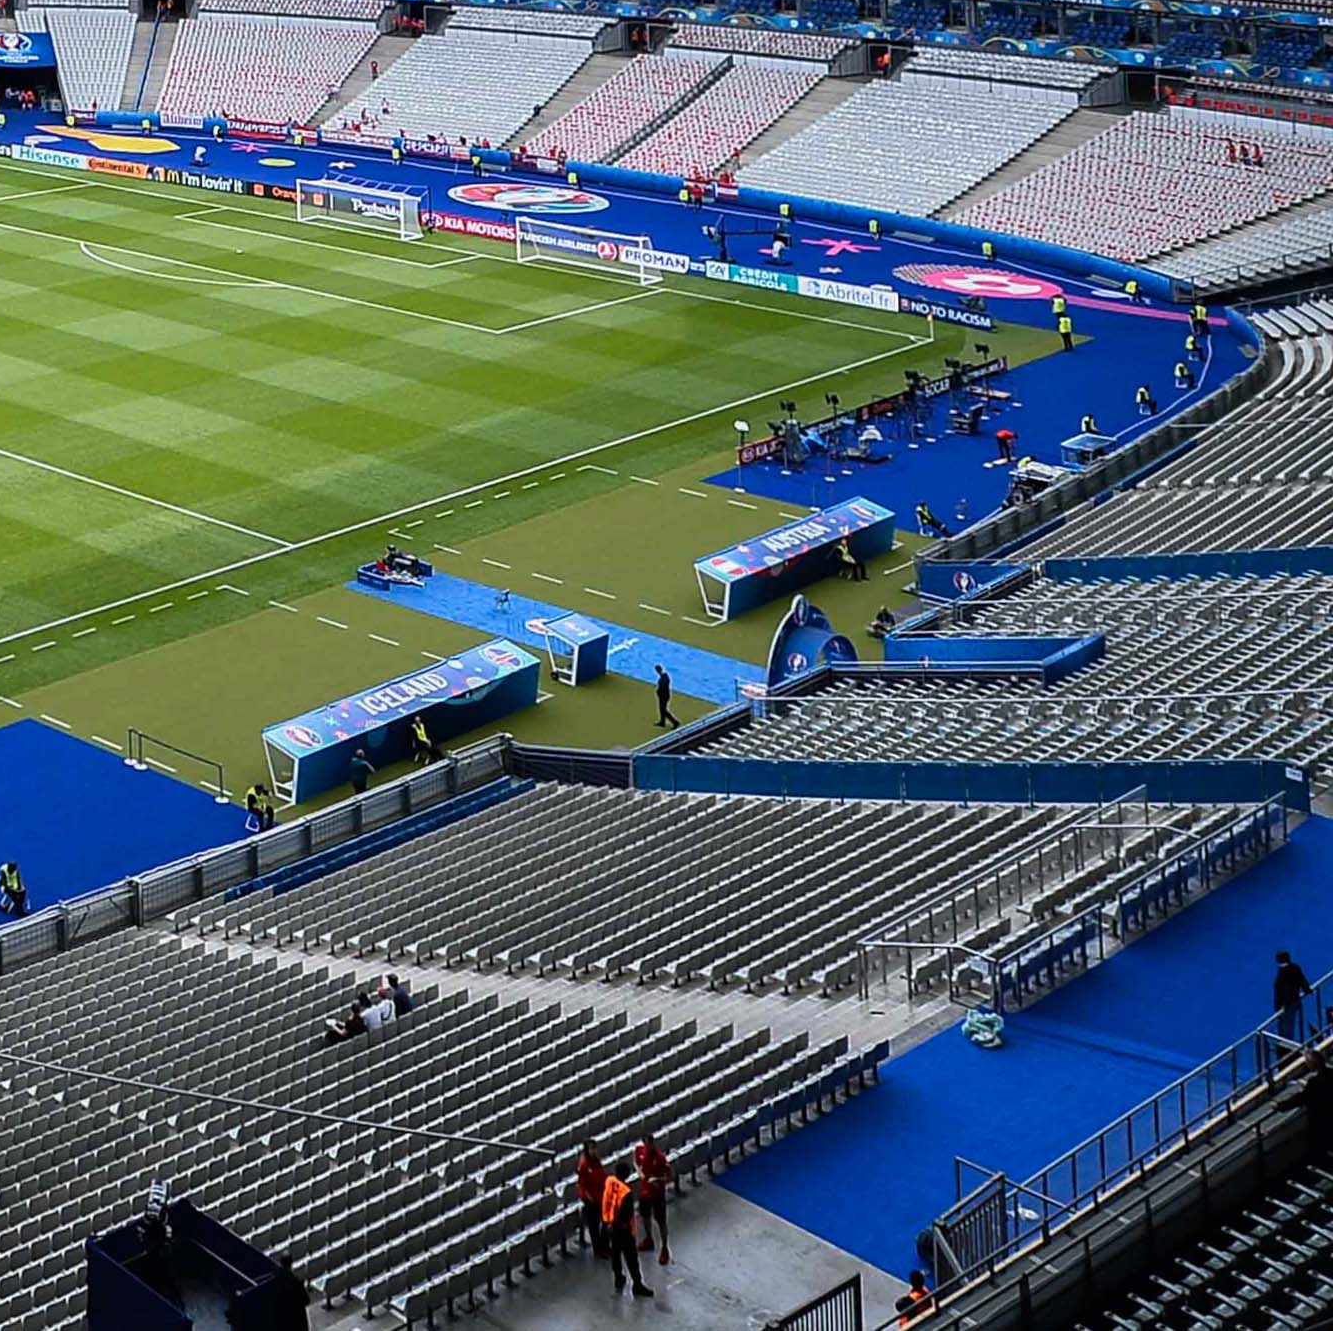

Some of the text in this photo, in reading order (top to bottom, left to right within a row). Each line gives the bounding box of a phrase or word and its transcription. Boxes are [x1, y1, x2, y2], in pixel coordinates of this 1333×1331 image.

[19, 146, 81, 168] Hisense
[88, 159, 134, 174] Continental
[181, 172, 243, 194] I'm lovin' it
[444, 218, 465, 232] KIA
[466, 222, 516, 240] MOTORS
[518, 232, 597, 252] TURKISH AIRLINES
[625, 248, 687, 270] PROMAN
[732, 274, 788, 292] AGRICOLE
[911, 298, 992, 329] NO TO RACISM
[760, 522, 832, 553] AUSTRIA
[355, 672, 448, 715] ICELAND
